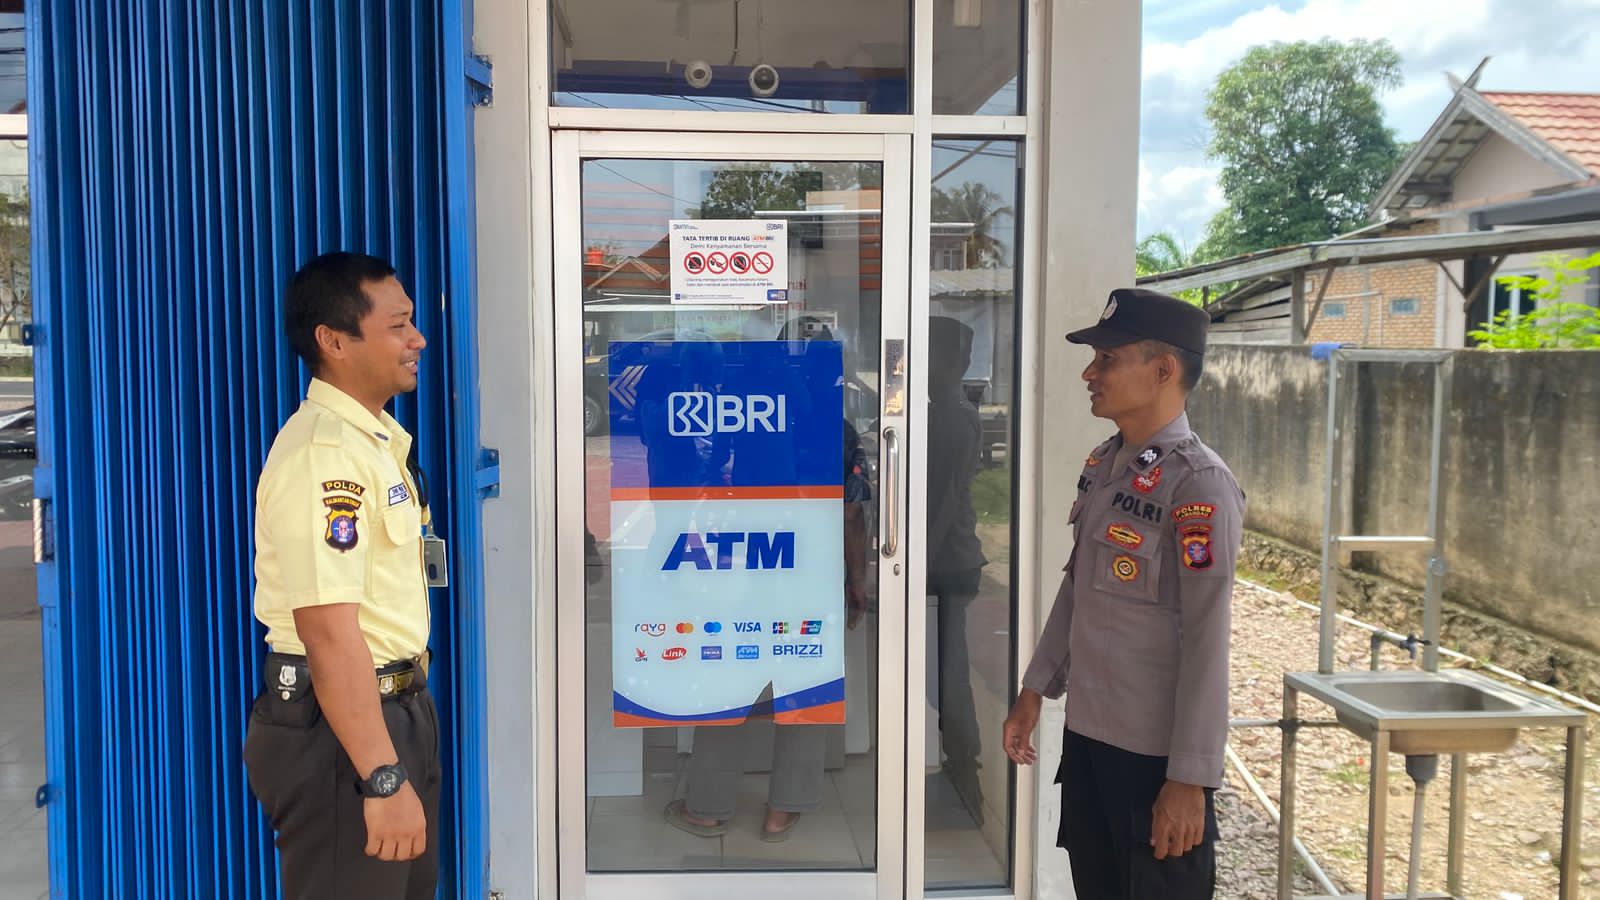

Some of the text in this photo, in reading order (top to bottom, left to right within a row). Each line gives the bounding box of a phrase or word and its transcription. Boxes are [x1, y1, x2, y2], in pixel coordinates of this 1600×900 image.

[716, 394, 786, 433] BRI
[325, 482, 361, 495] POLDA
[1112, 492, 1163, 523] POLRI
[1175, 505, 1212, 517] POLRES
[661, 532, 795, 571] ATM
[635, 624, 666, 633] raya
[733, 622, 761, 633] VISA
[663, 649, 685, 658] Link
[773, 645, 822, 655] BRIZZI
